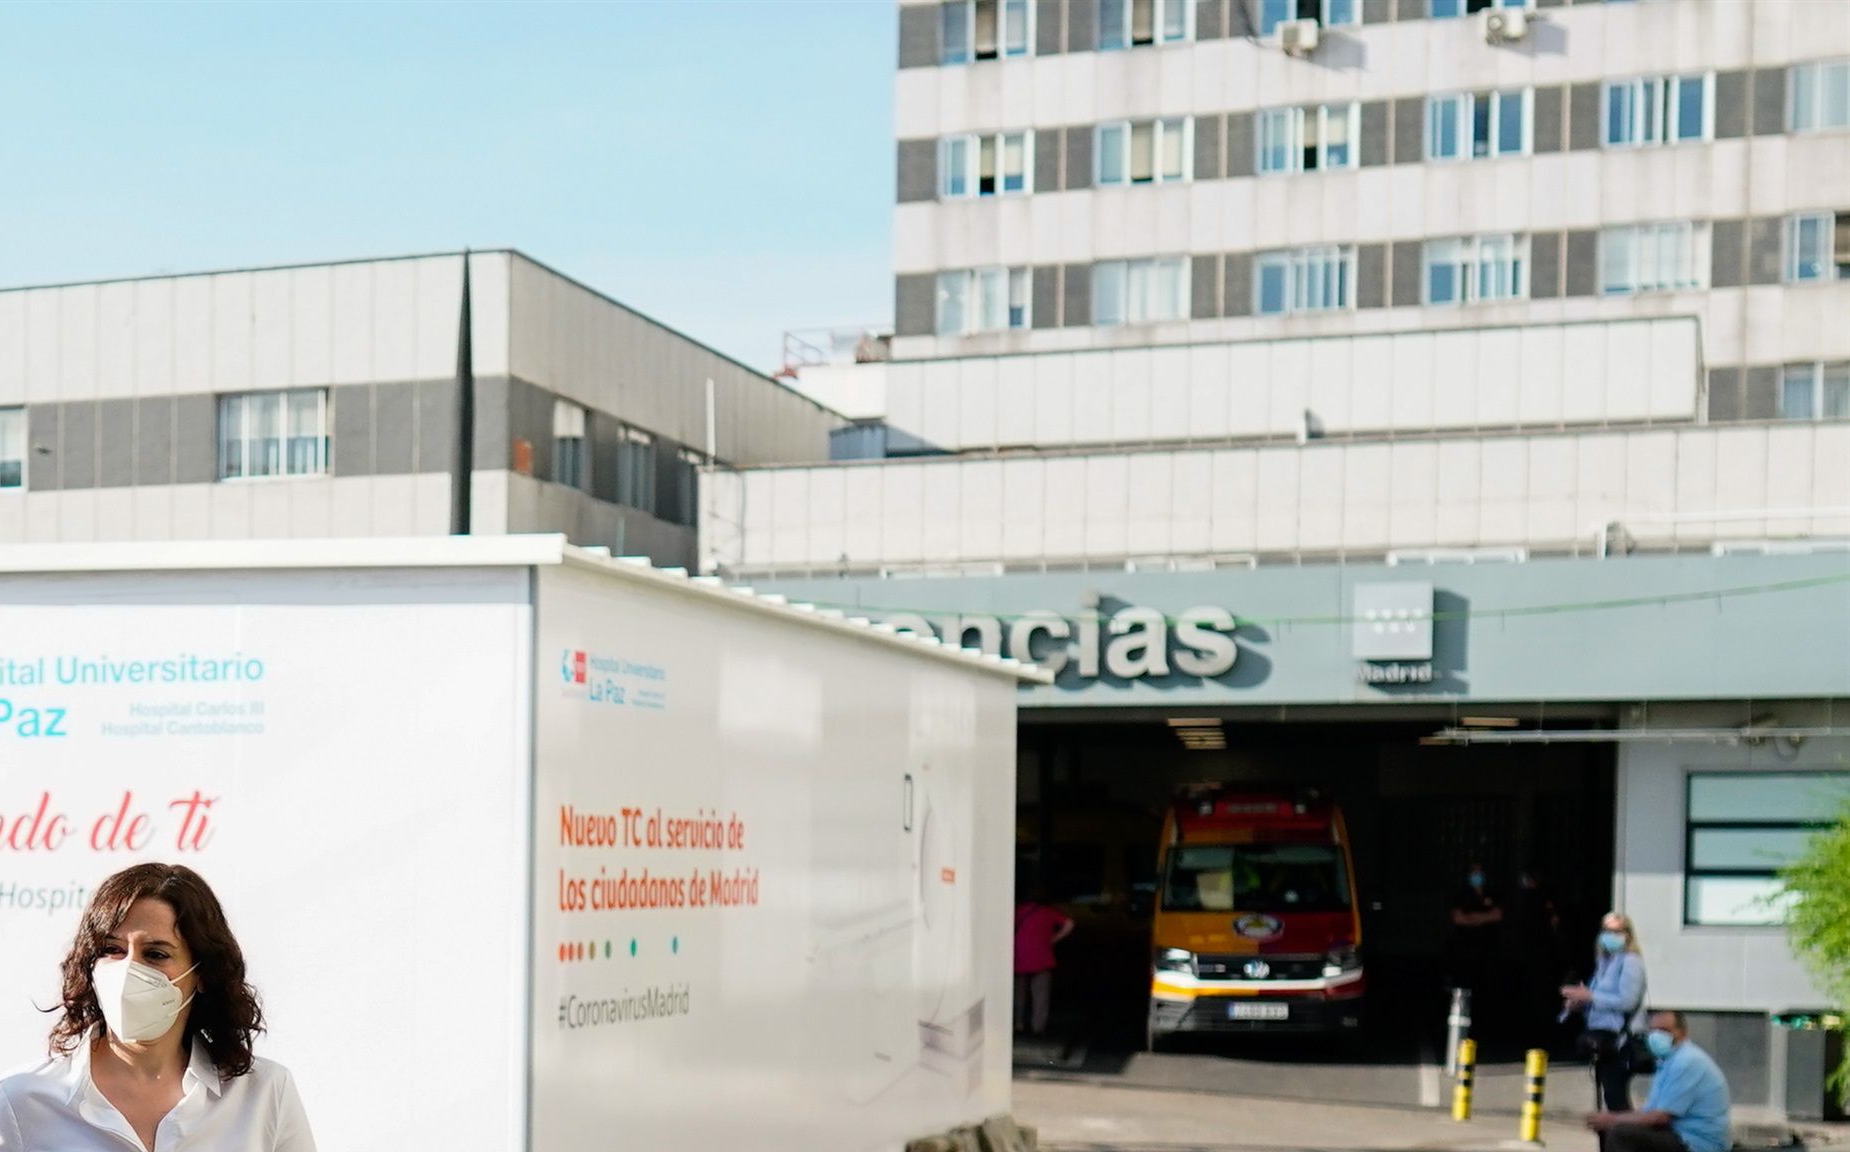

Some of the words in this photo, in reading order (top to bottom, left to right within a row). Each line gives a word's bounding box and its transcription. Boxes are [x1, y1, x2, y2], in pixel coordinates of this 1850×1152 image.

[57, 652, 264, 684] Universitario
[1357, 661, 1433, 684] Madrid
[90, 790, 154, 851] de
[167, 790, 220, 851] ti
[560, 805, 617, 847] Nuevo
[621, 807, 643, 848] TC
[647, 807, 663, 848] al
[667, 808, 724, 849] servicio
[728, 811, 744, 849] de
[591, 865, 685, 910] ciudadanos
[690, 867, 706, 908] de
[710, 866, 759, 906] Madrid
[558, 981, 690, 1029] #CoronavirusMadrid
